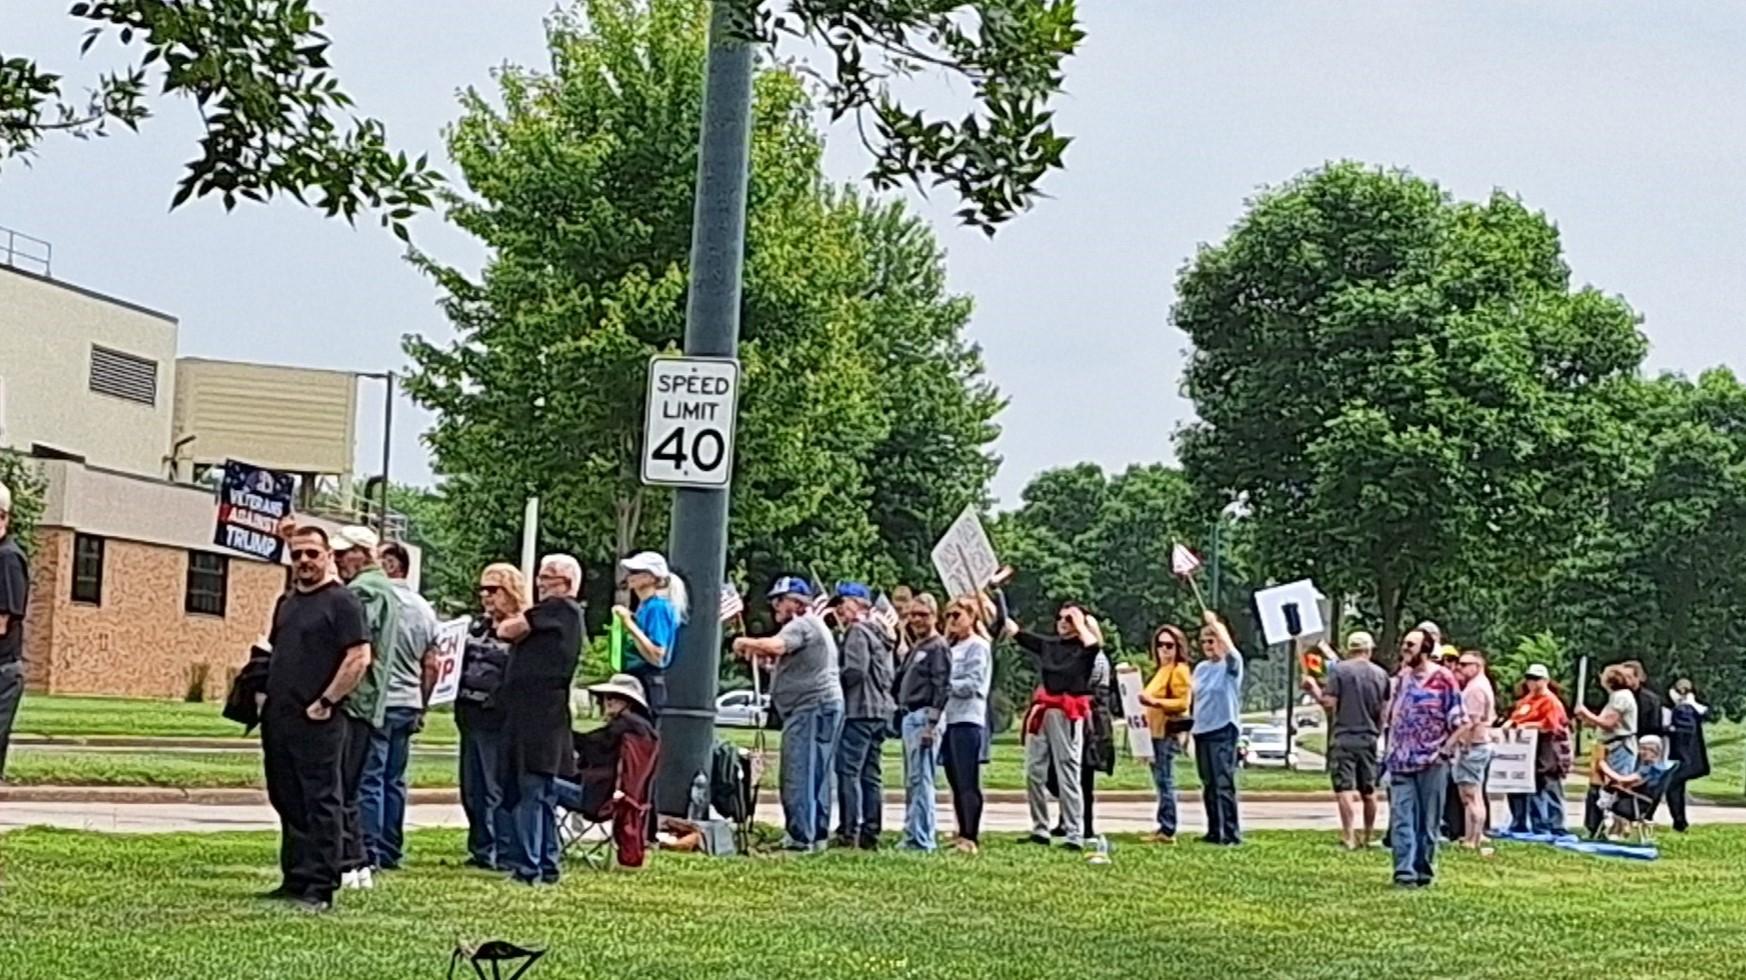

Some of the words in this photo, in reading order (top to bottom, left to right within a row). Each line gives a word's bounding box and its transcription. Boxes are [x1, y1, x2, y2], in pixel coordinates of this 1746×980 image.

[657, 375, 729, 395] SPEED
[663, 400, 719, 421] LIMIT
[651, 426, 725, 472] 40
[230, 487, 283, 517] VETERANS
[226, 525, 277, 558] TRUMP
